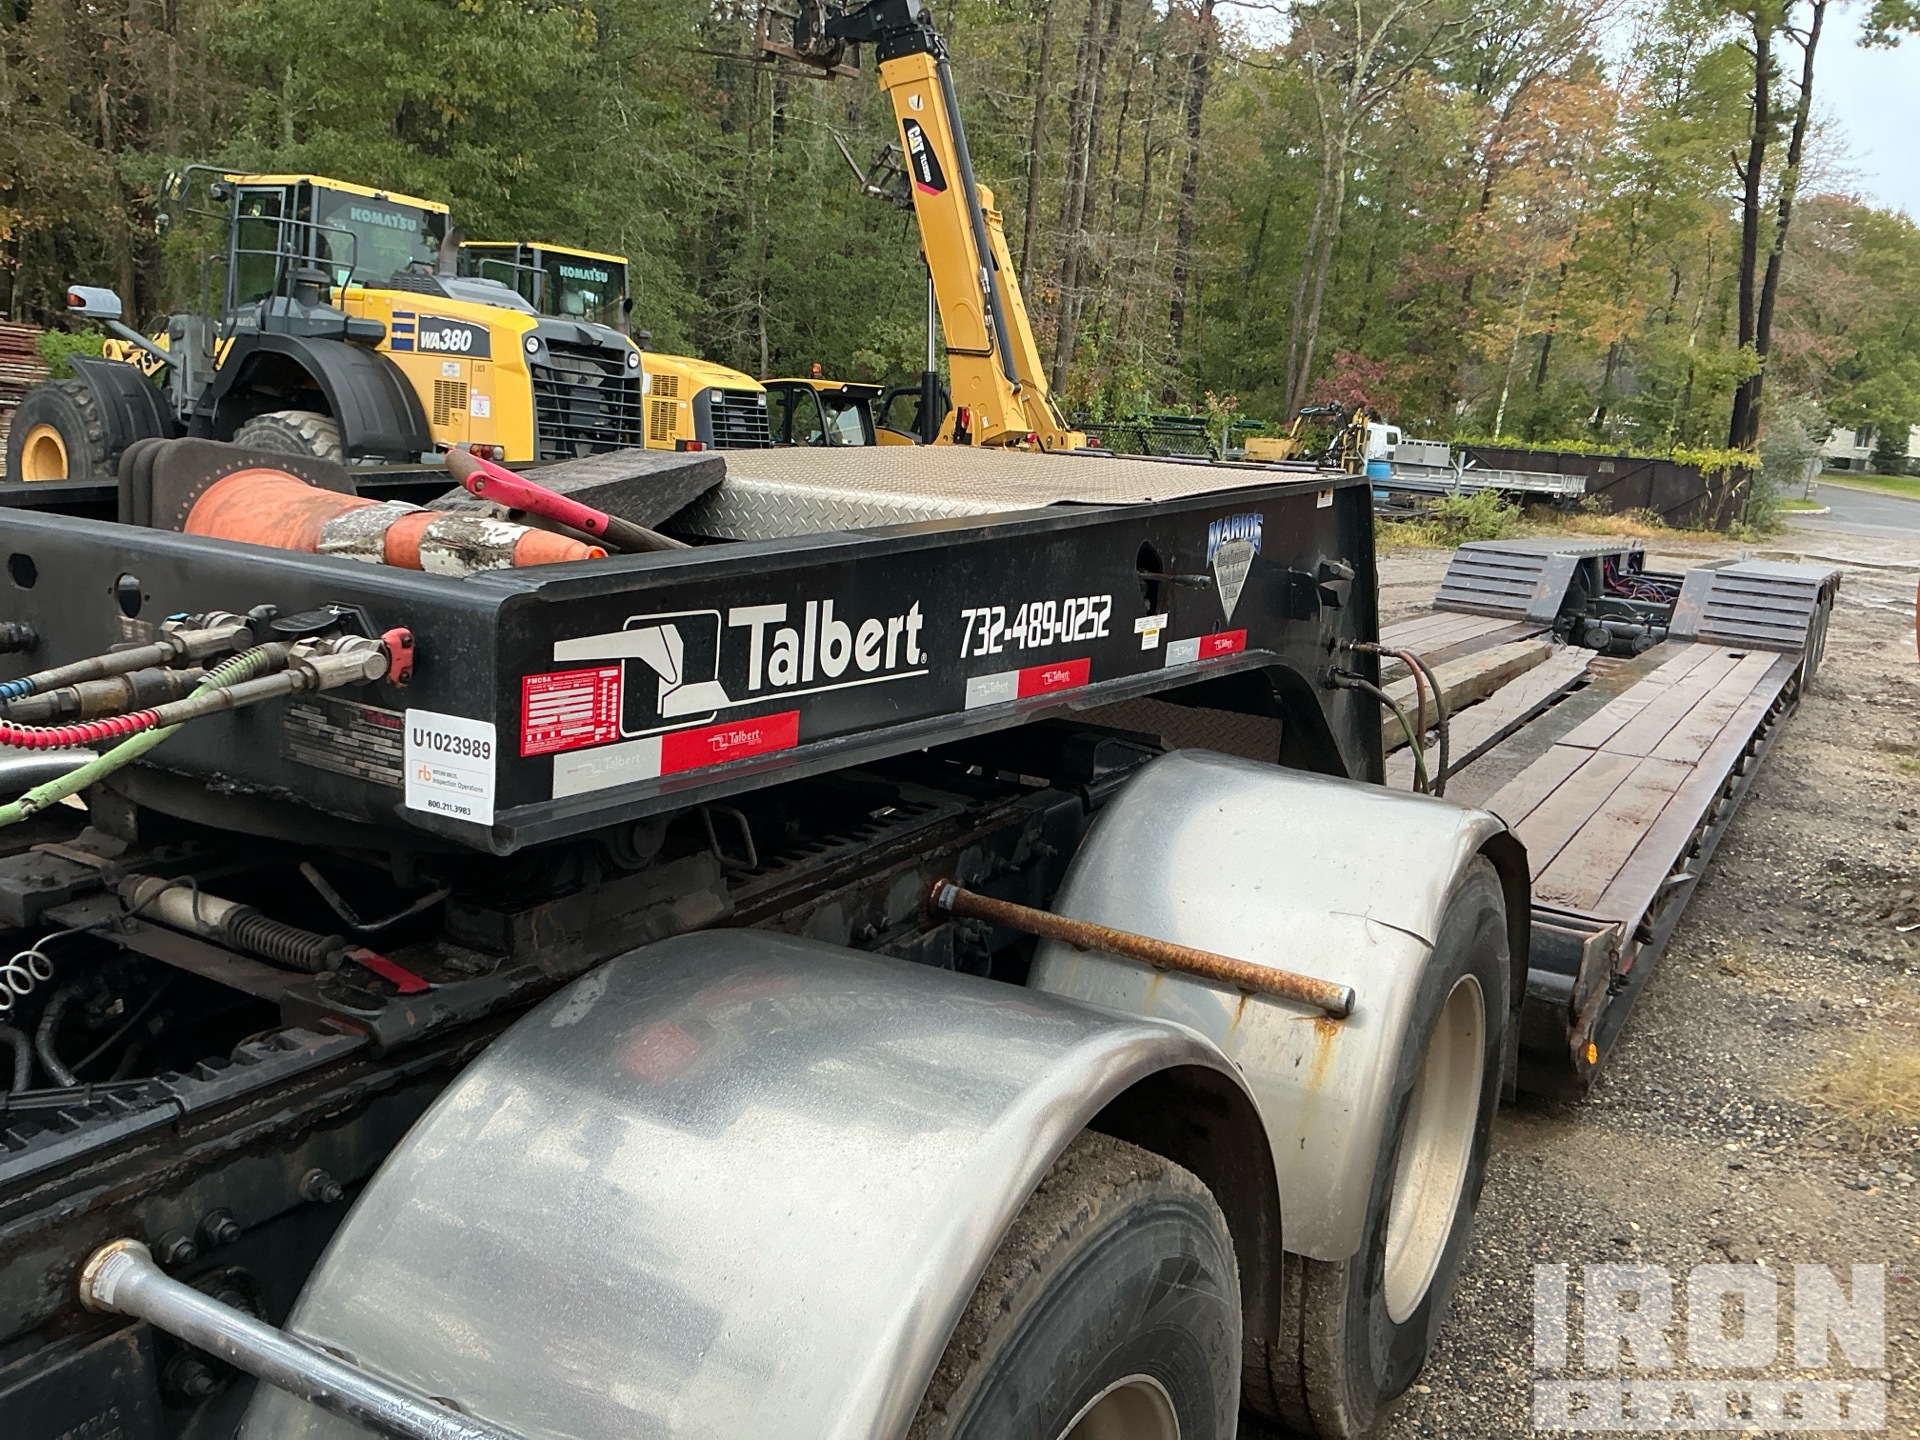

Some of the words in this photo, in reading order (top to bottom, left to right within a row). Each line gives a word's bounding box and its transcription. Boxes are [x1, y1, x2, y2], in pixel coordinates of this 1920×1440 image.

[908, 125, 924, 154] CAT
[351, 207, 417, 231] KOMATSU
[559, 264, 608, 283] KOMATSU
[420, 328, 472, 351] WA380
[960, 595, 1112, 658] 732-489-0252
[728, 599, 924, 690] Talbert
[413, 728, 491, 760] U1023989
[728, 729, 760, 745] Talbert
[417, 765, 431, 781] rb
[432, 777, 457, 788] Inspection
[457, 782, 483, 793] Operations
[428, 799, 471, 816] 800.211.3983
